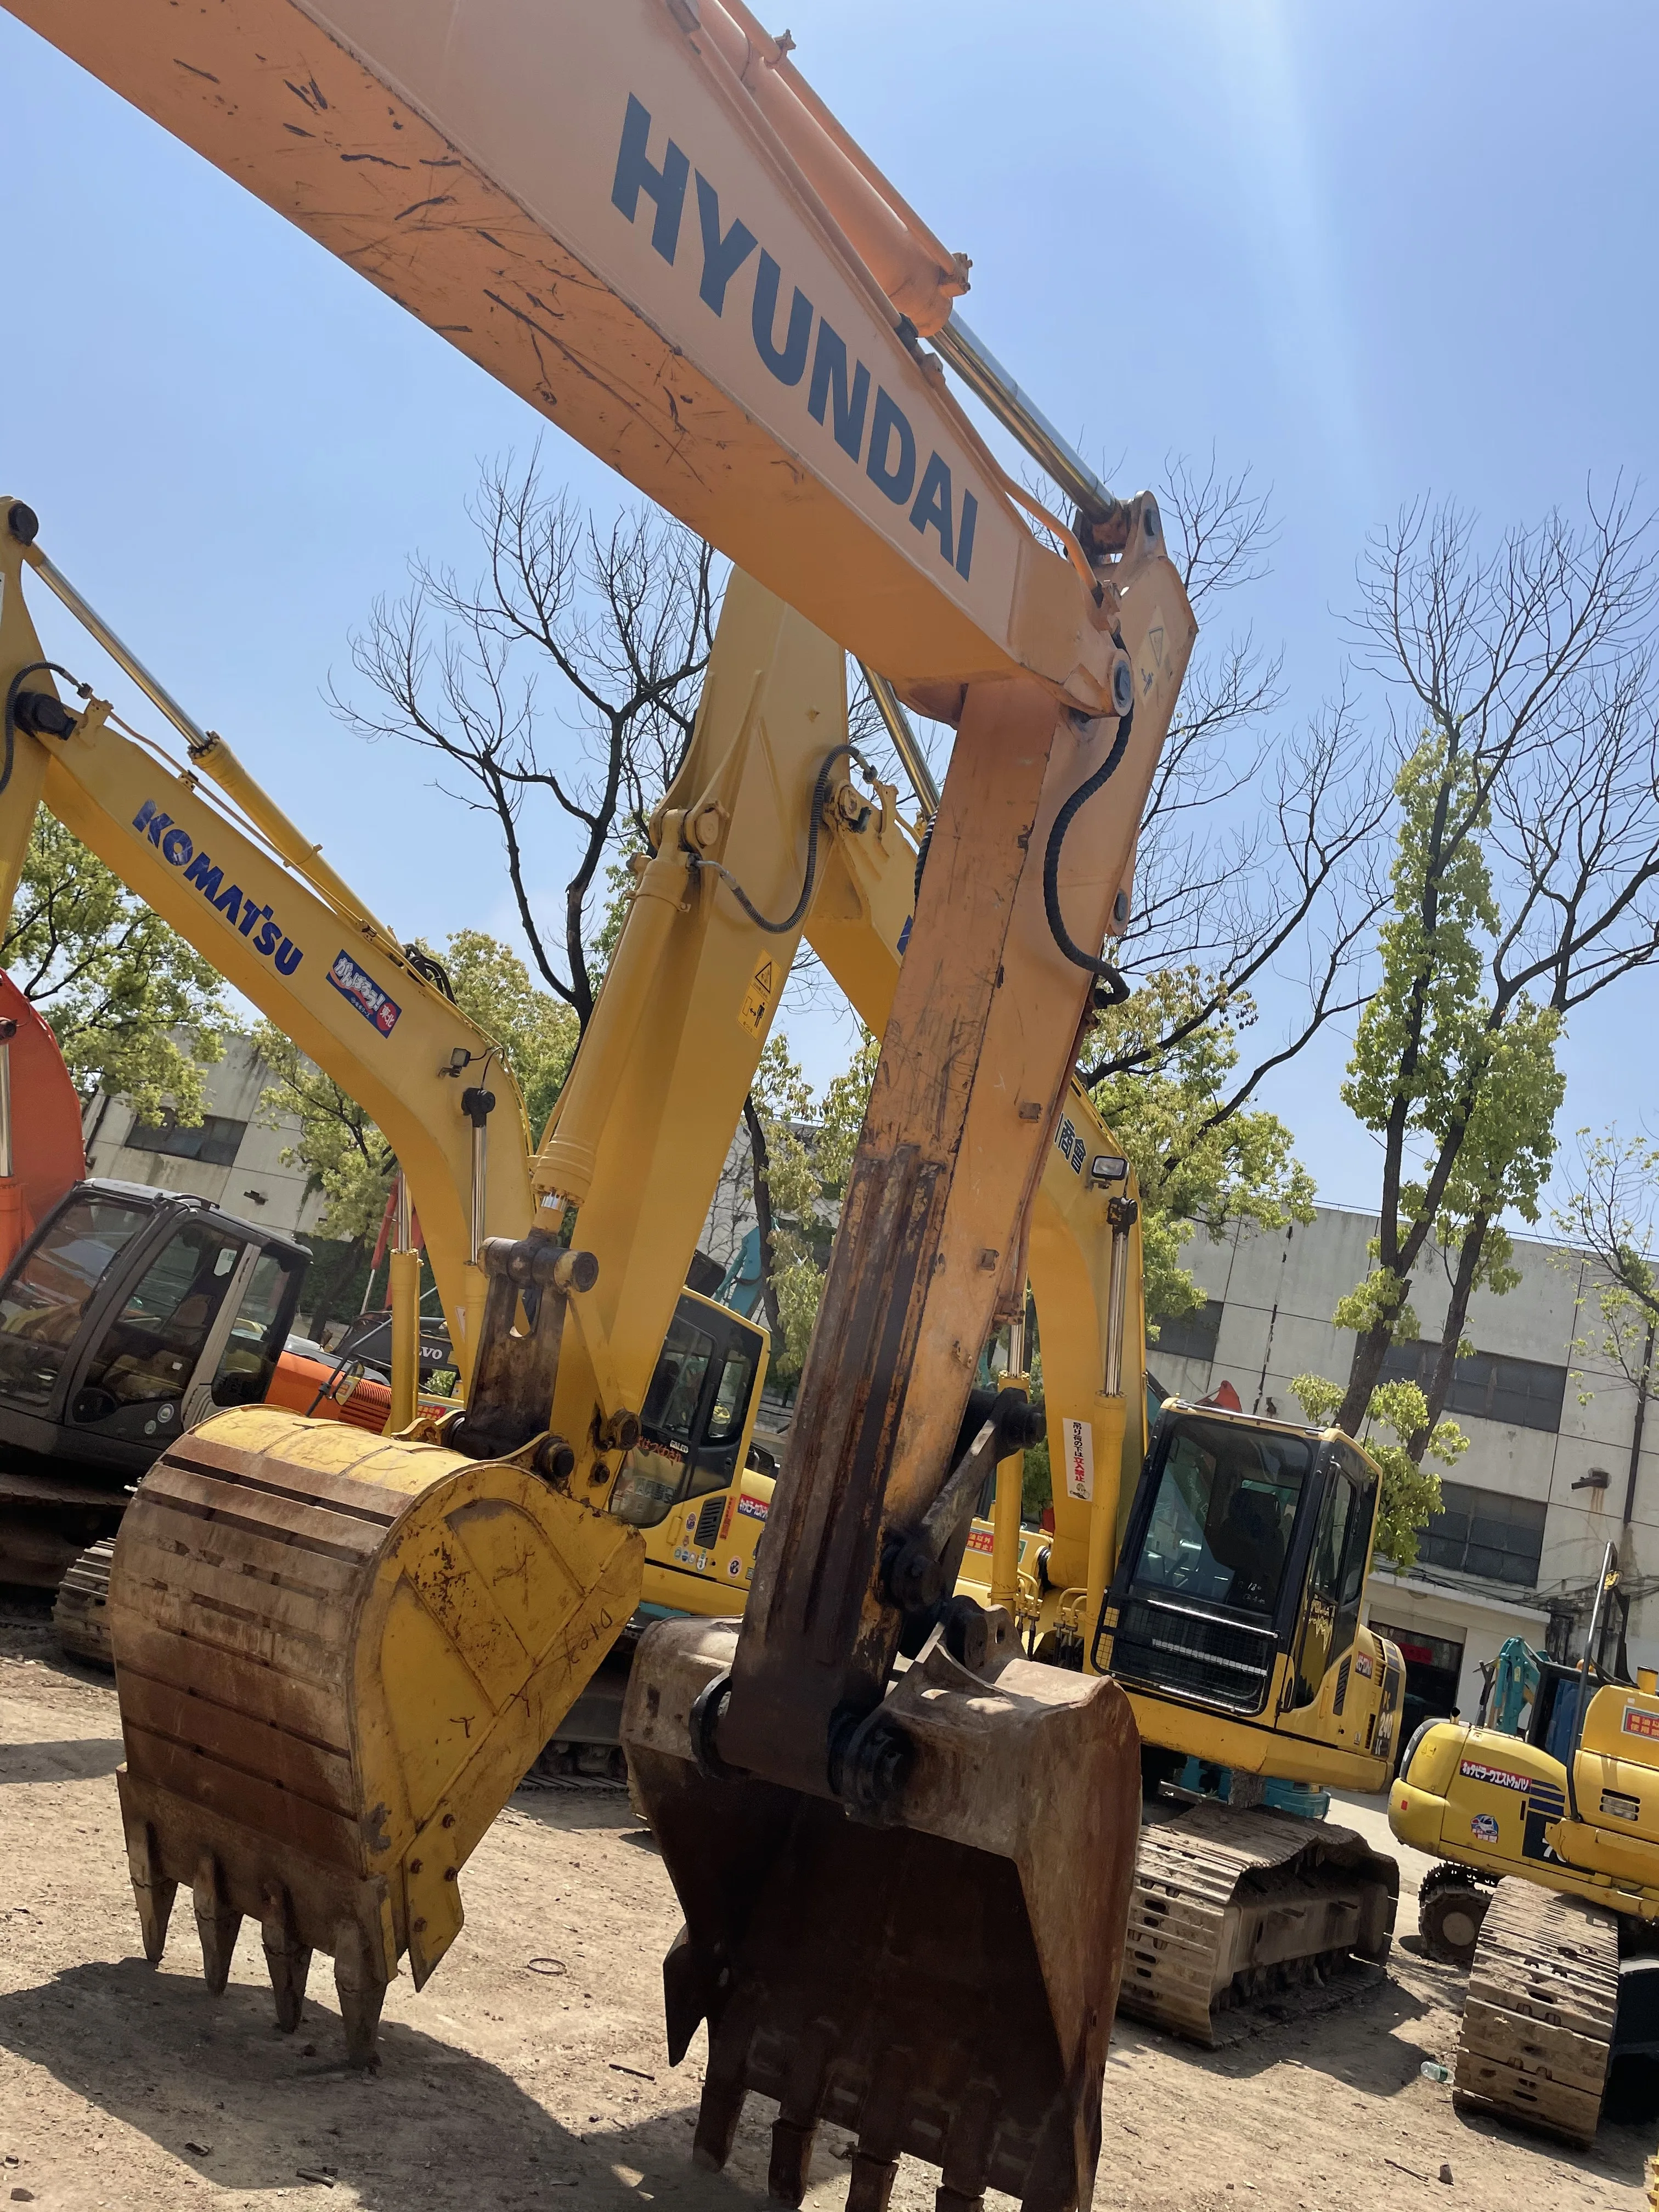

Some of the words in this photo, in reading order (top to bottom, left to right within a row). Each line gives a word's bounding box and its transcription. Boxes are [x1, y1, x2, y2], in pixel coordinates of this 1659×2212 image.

[612, 92, 978, 582] HYUNDAI
[132, 799, 304, 975] KOMATSU
[380, 1005, 406, 1028] 東北
[1054, 1113, 1086, 1175] 商會
[1378, 1711, 1393, 1740] 240
